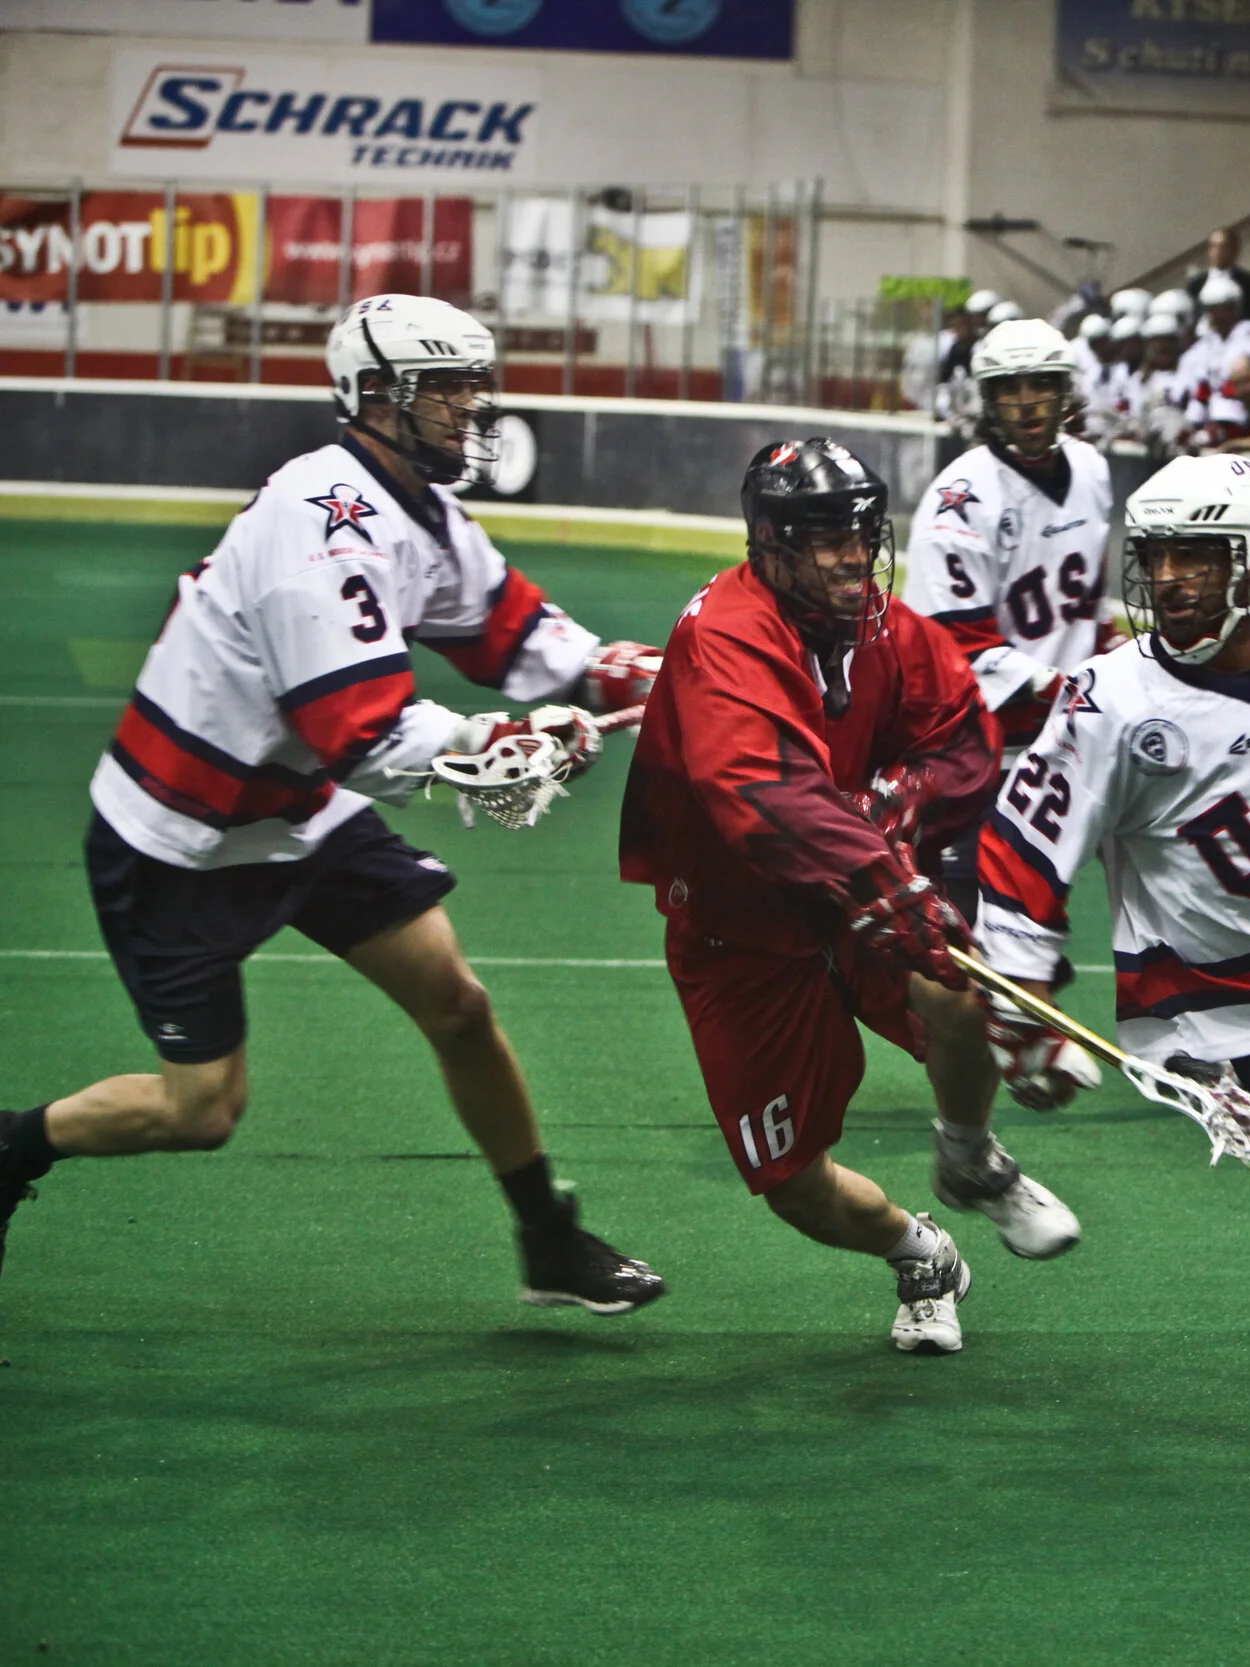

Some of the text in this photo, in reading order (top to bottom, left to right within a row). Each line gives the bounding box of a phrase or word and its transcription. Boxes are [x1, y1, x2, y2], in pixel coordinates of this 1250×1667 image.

[148, 77, 535, 145] SCHRACK
[351, 144, 516, 171] TECHNIK
[341, 574, 387, 643] 3
[1006, 752, 1070, 845] 22
[739, 1093, 795, 1169] 16
